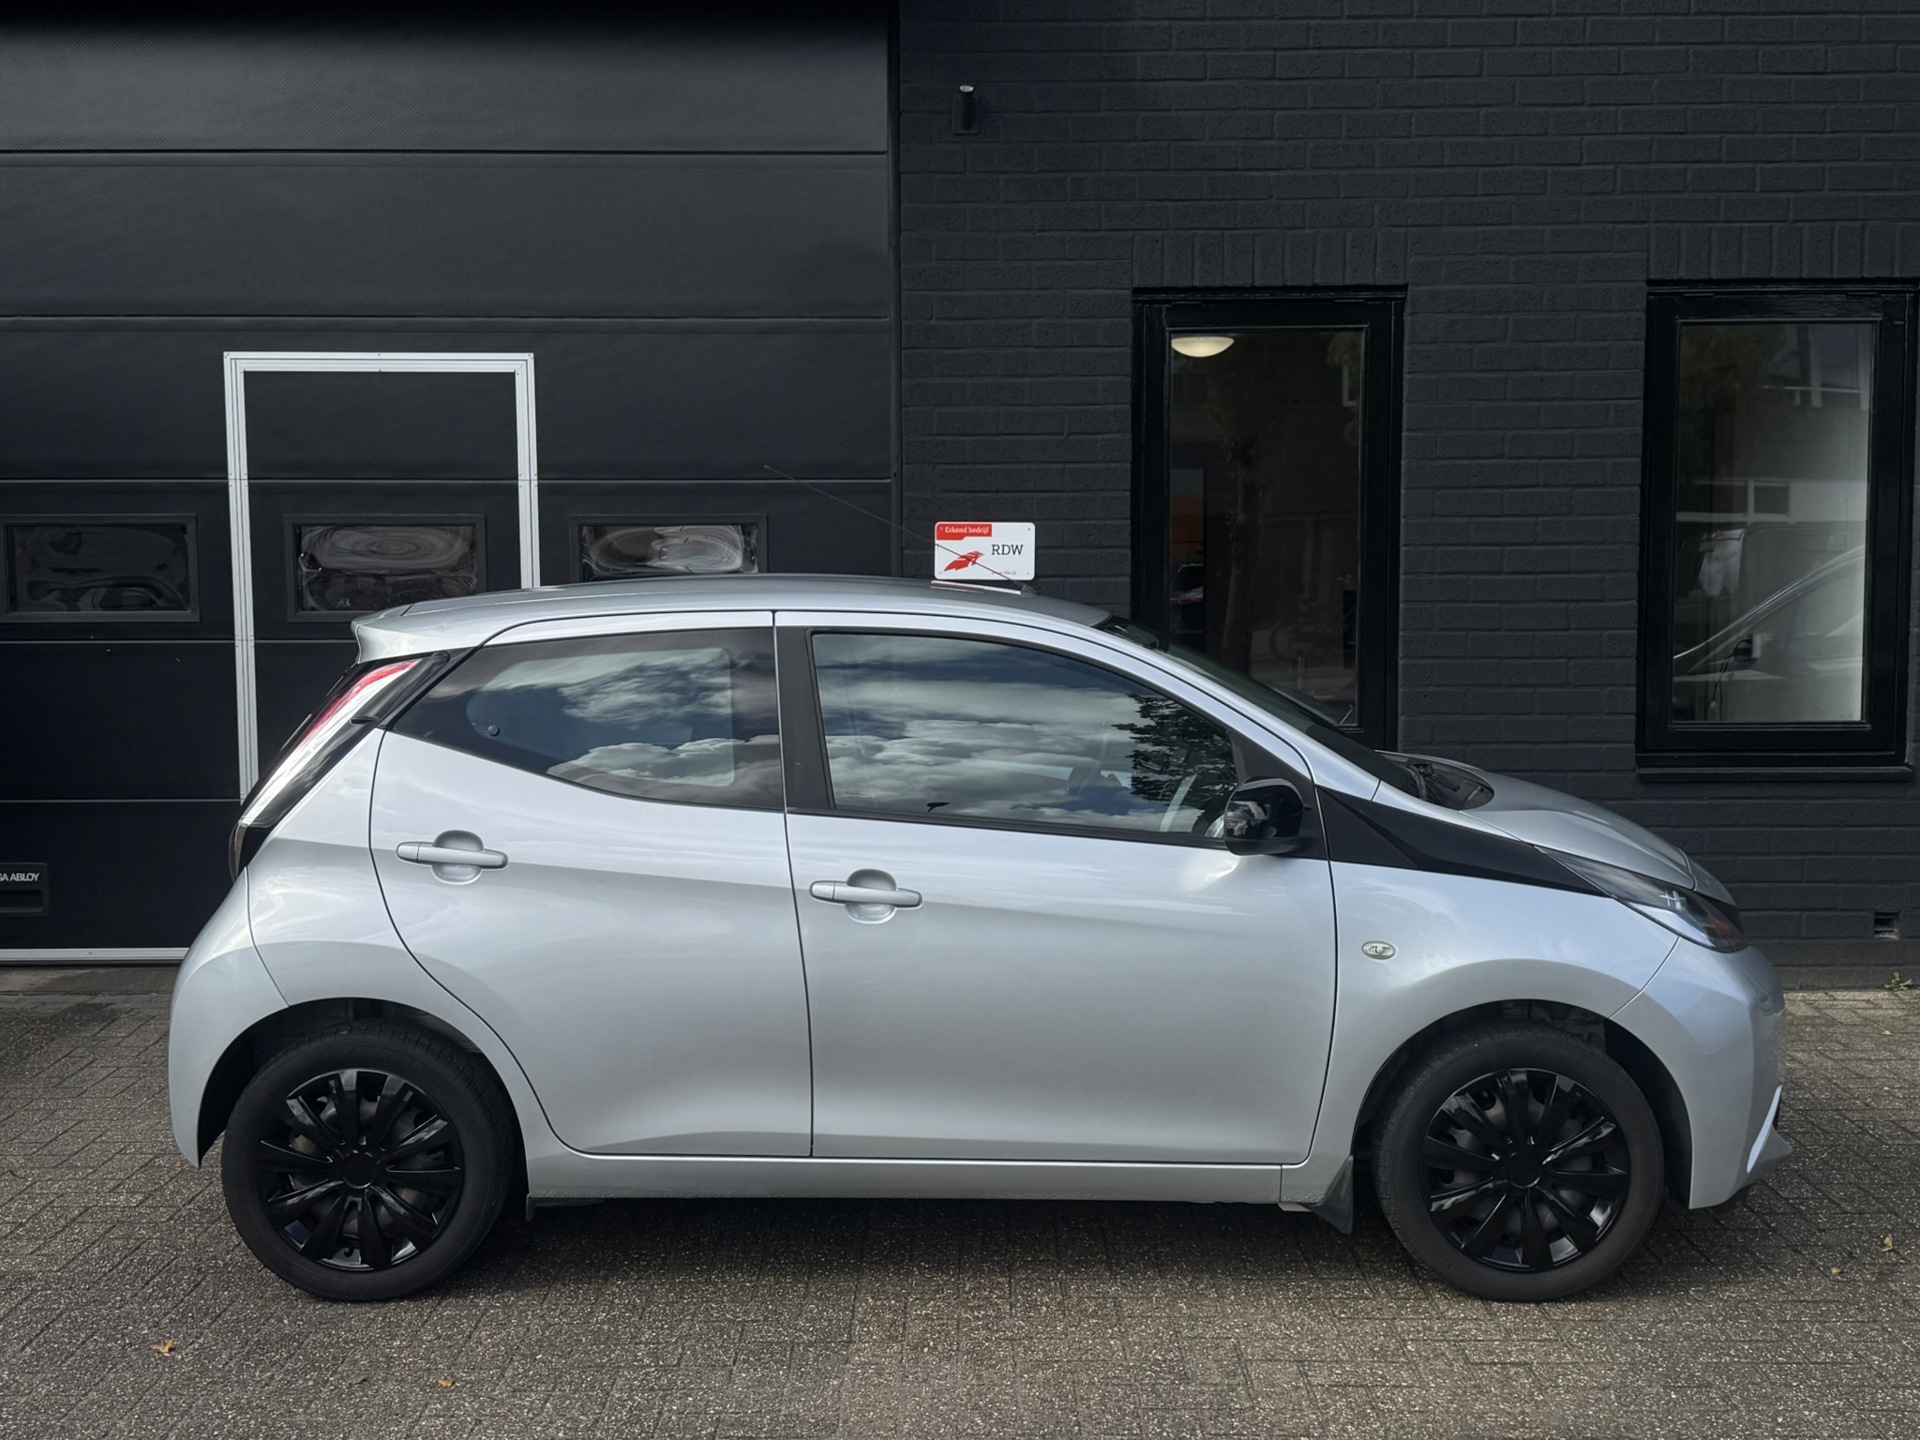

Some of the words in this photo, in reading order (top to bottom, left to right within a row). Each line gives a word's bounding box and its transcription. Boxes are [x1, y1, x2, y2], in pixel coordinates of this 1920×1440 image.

[944, 526, 968, 534] Erkend
[968, 526, 990, 535] bedrijf
[991, 544, 1023, 555] RDW
[10, 872, 40, 881] ABLOY
